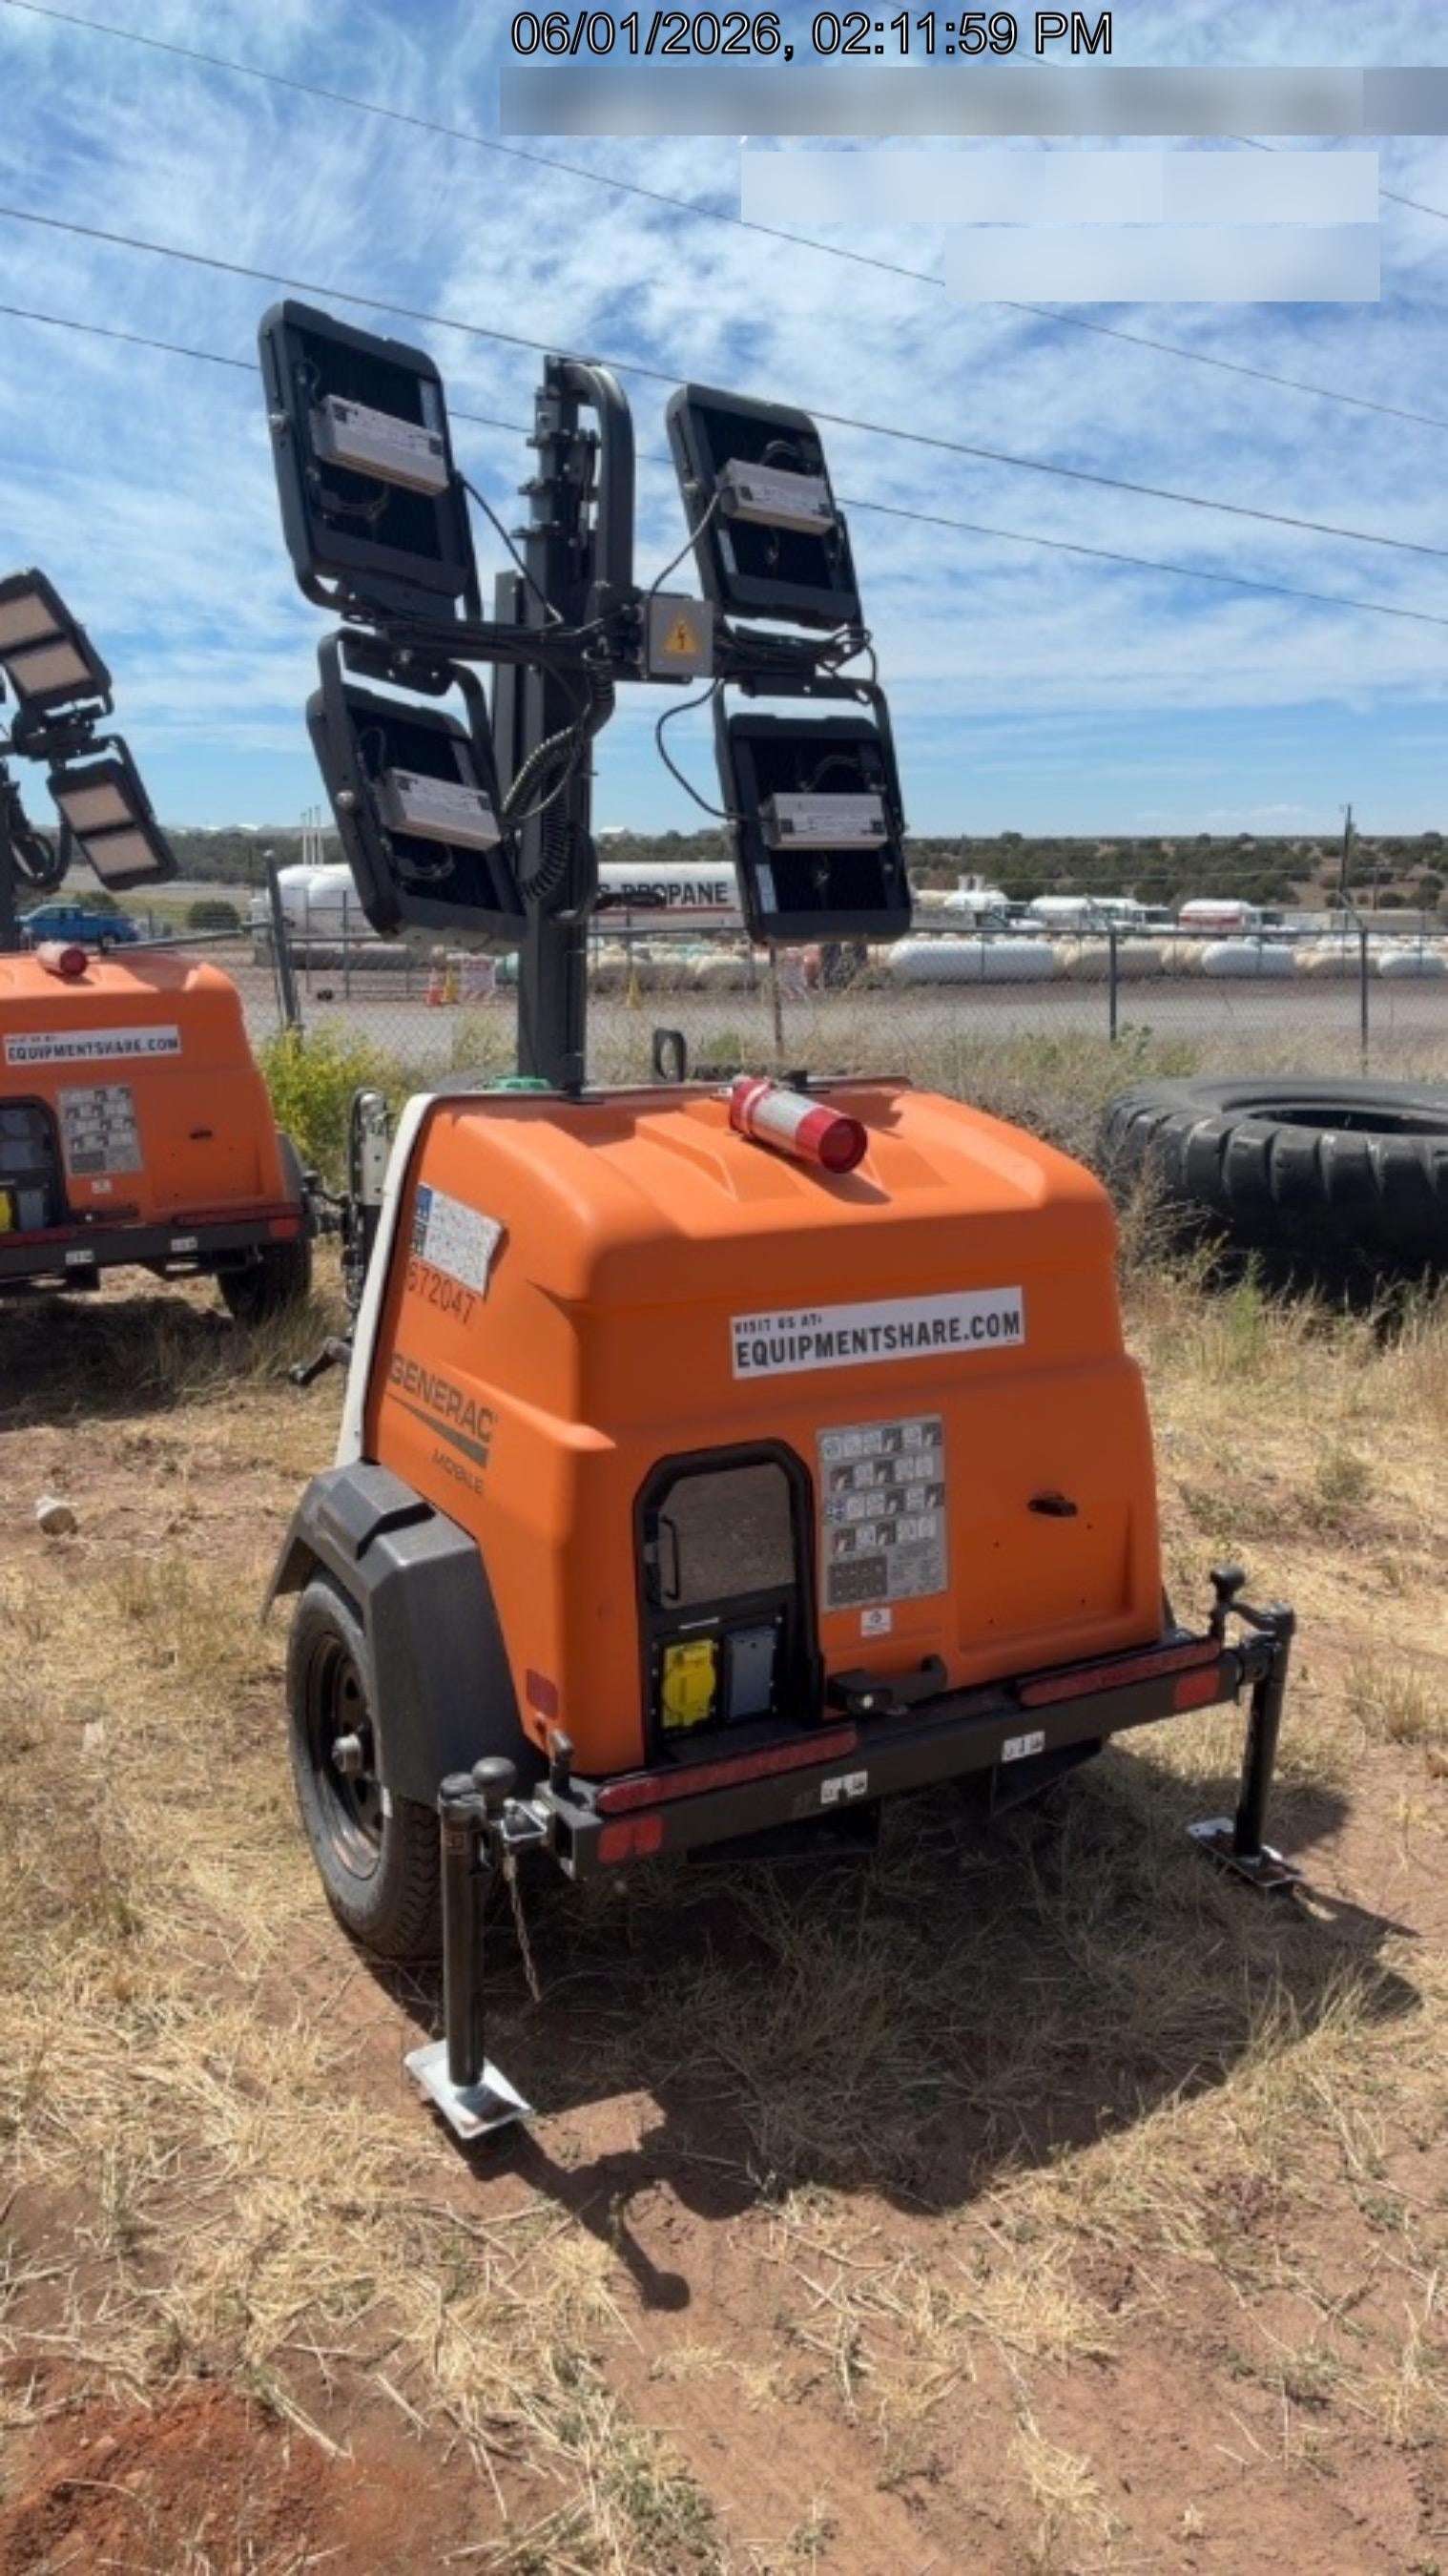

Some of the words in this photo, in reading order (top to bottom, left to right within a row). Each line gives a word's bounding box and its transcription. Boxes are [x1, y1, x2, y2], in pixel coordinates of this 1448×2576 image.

[734, 1319, 771, 1334] VISIT
[777, 1316, 796, 1329] US
[735, 1311, 1021, 1368] EQUIPMENTSHARE.COM
[388, 1352, 496, 1444] GENERAC
[432, 1447, 484, 1495] MOBILE
